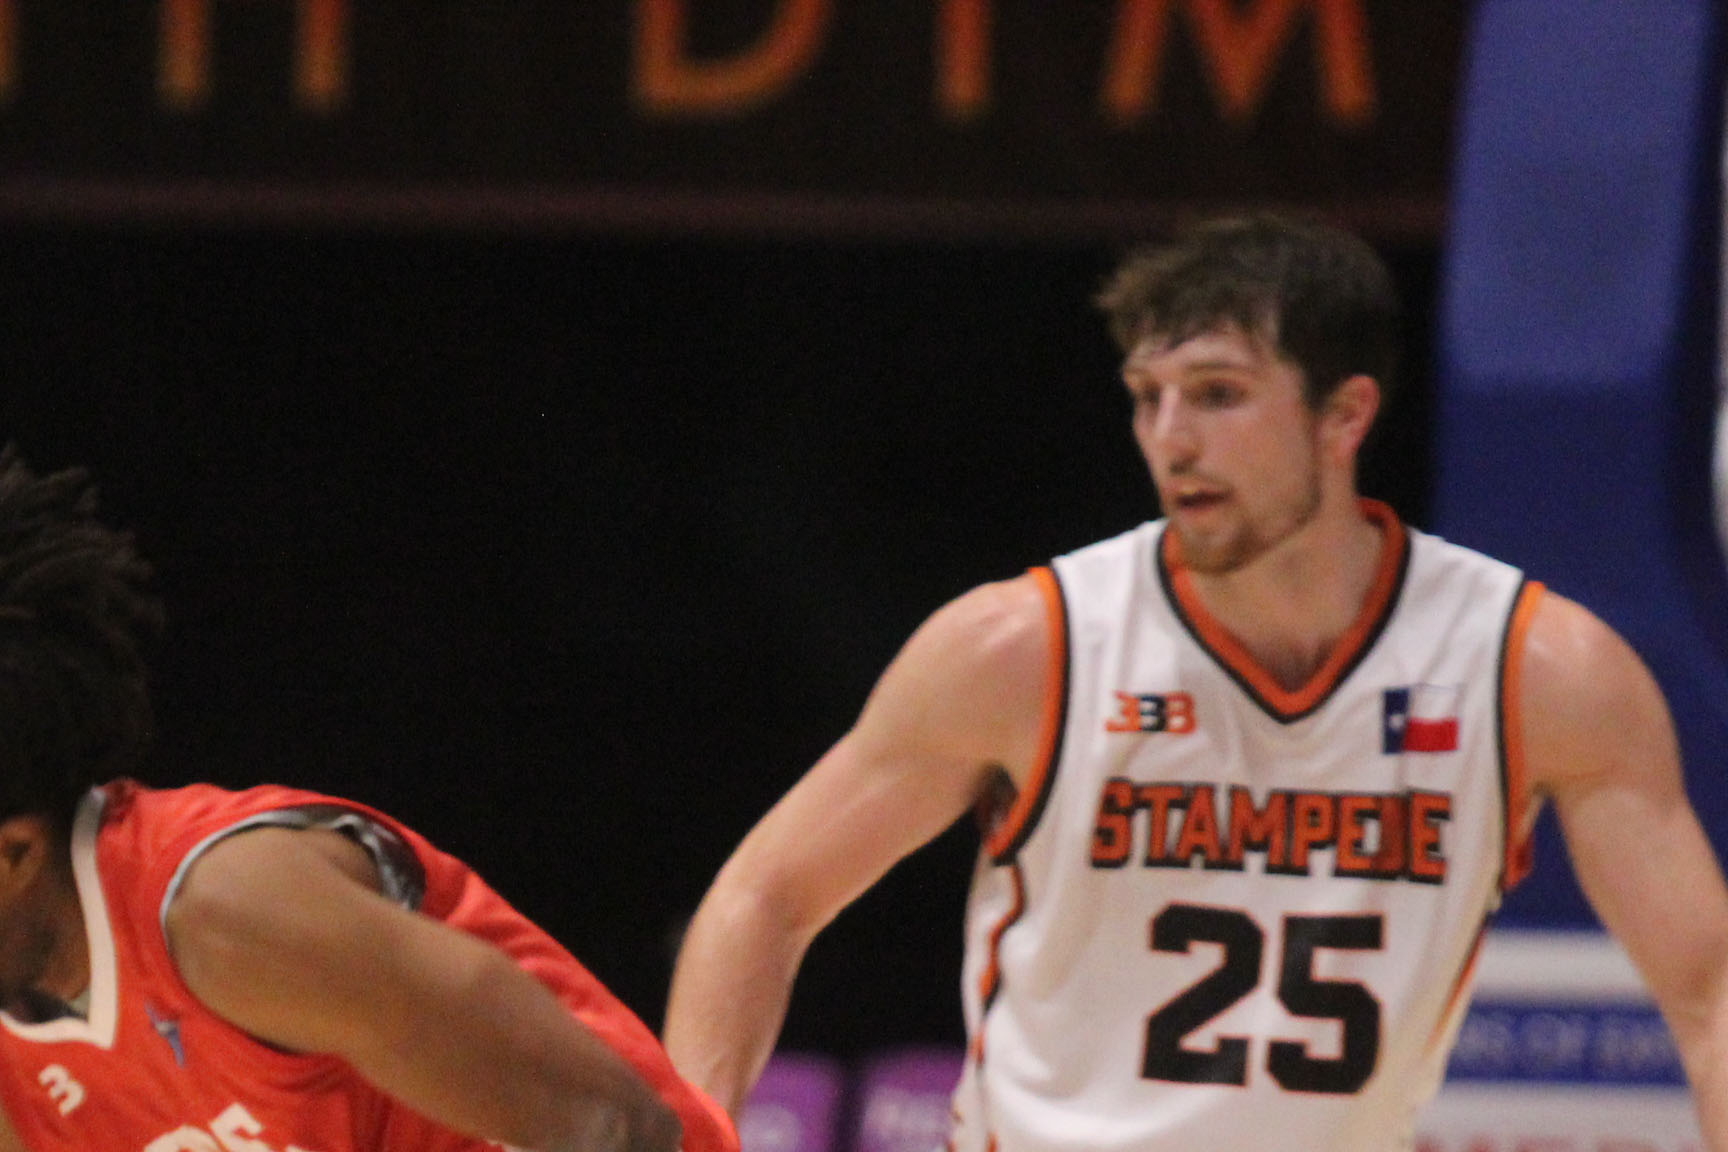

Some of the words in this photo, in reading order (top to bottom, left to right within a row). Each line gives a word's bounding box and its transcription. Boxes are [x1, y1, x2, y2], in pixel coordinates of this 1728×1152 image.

[1090, 777, 1453, 885] STAMPEDE
[1140, 901, 1385, 1095] 25
[38, 1063, 84, 1117] 3
